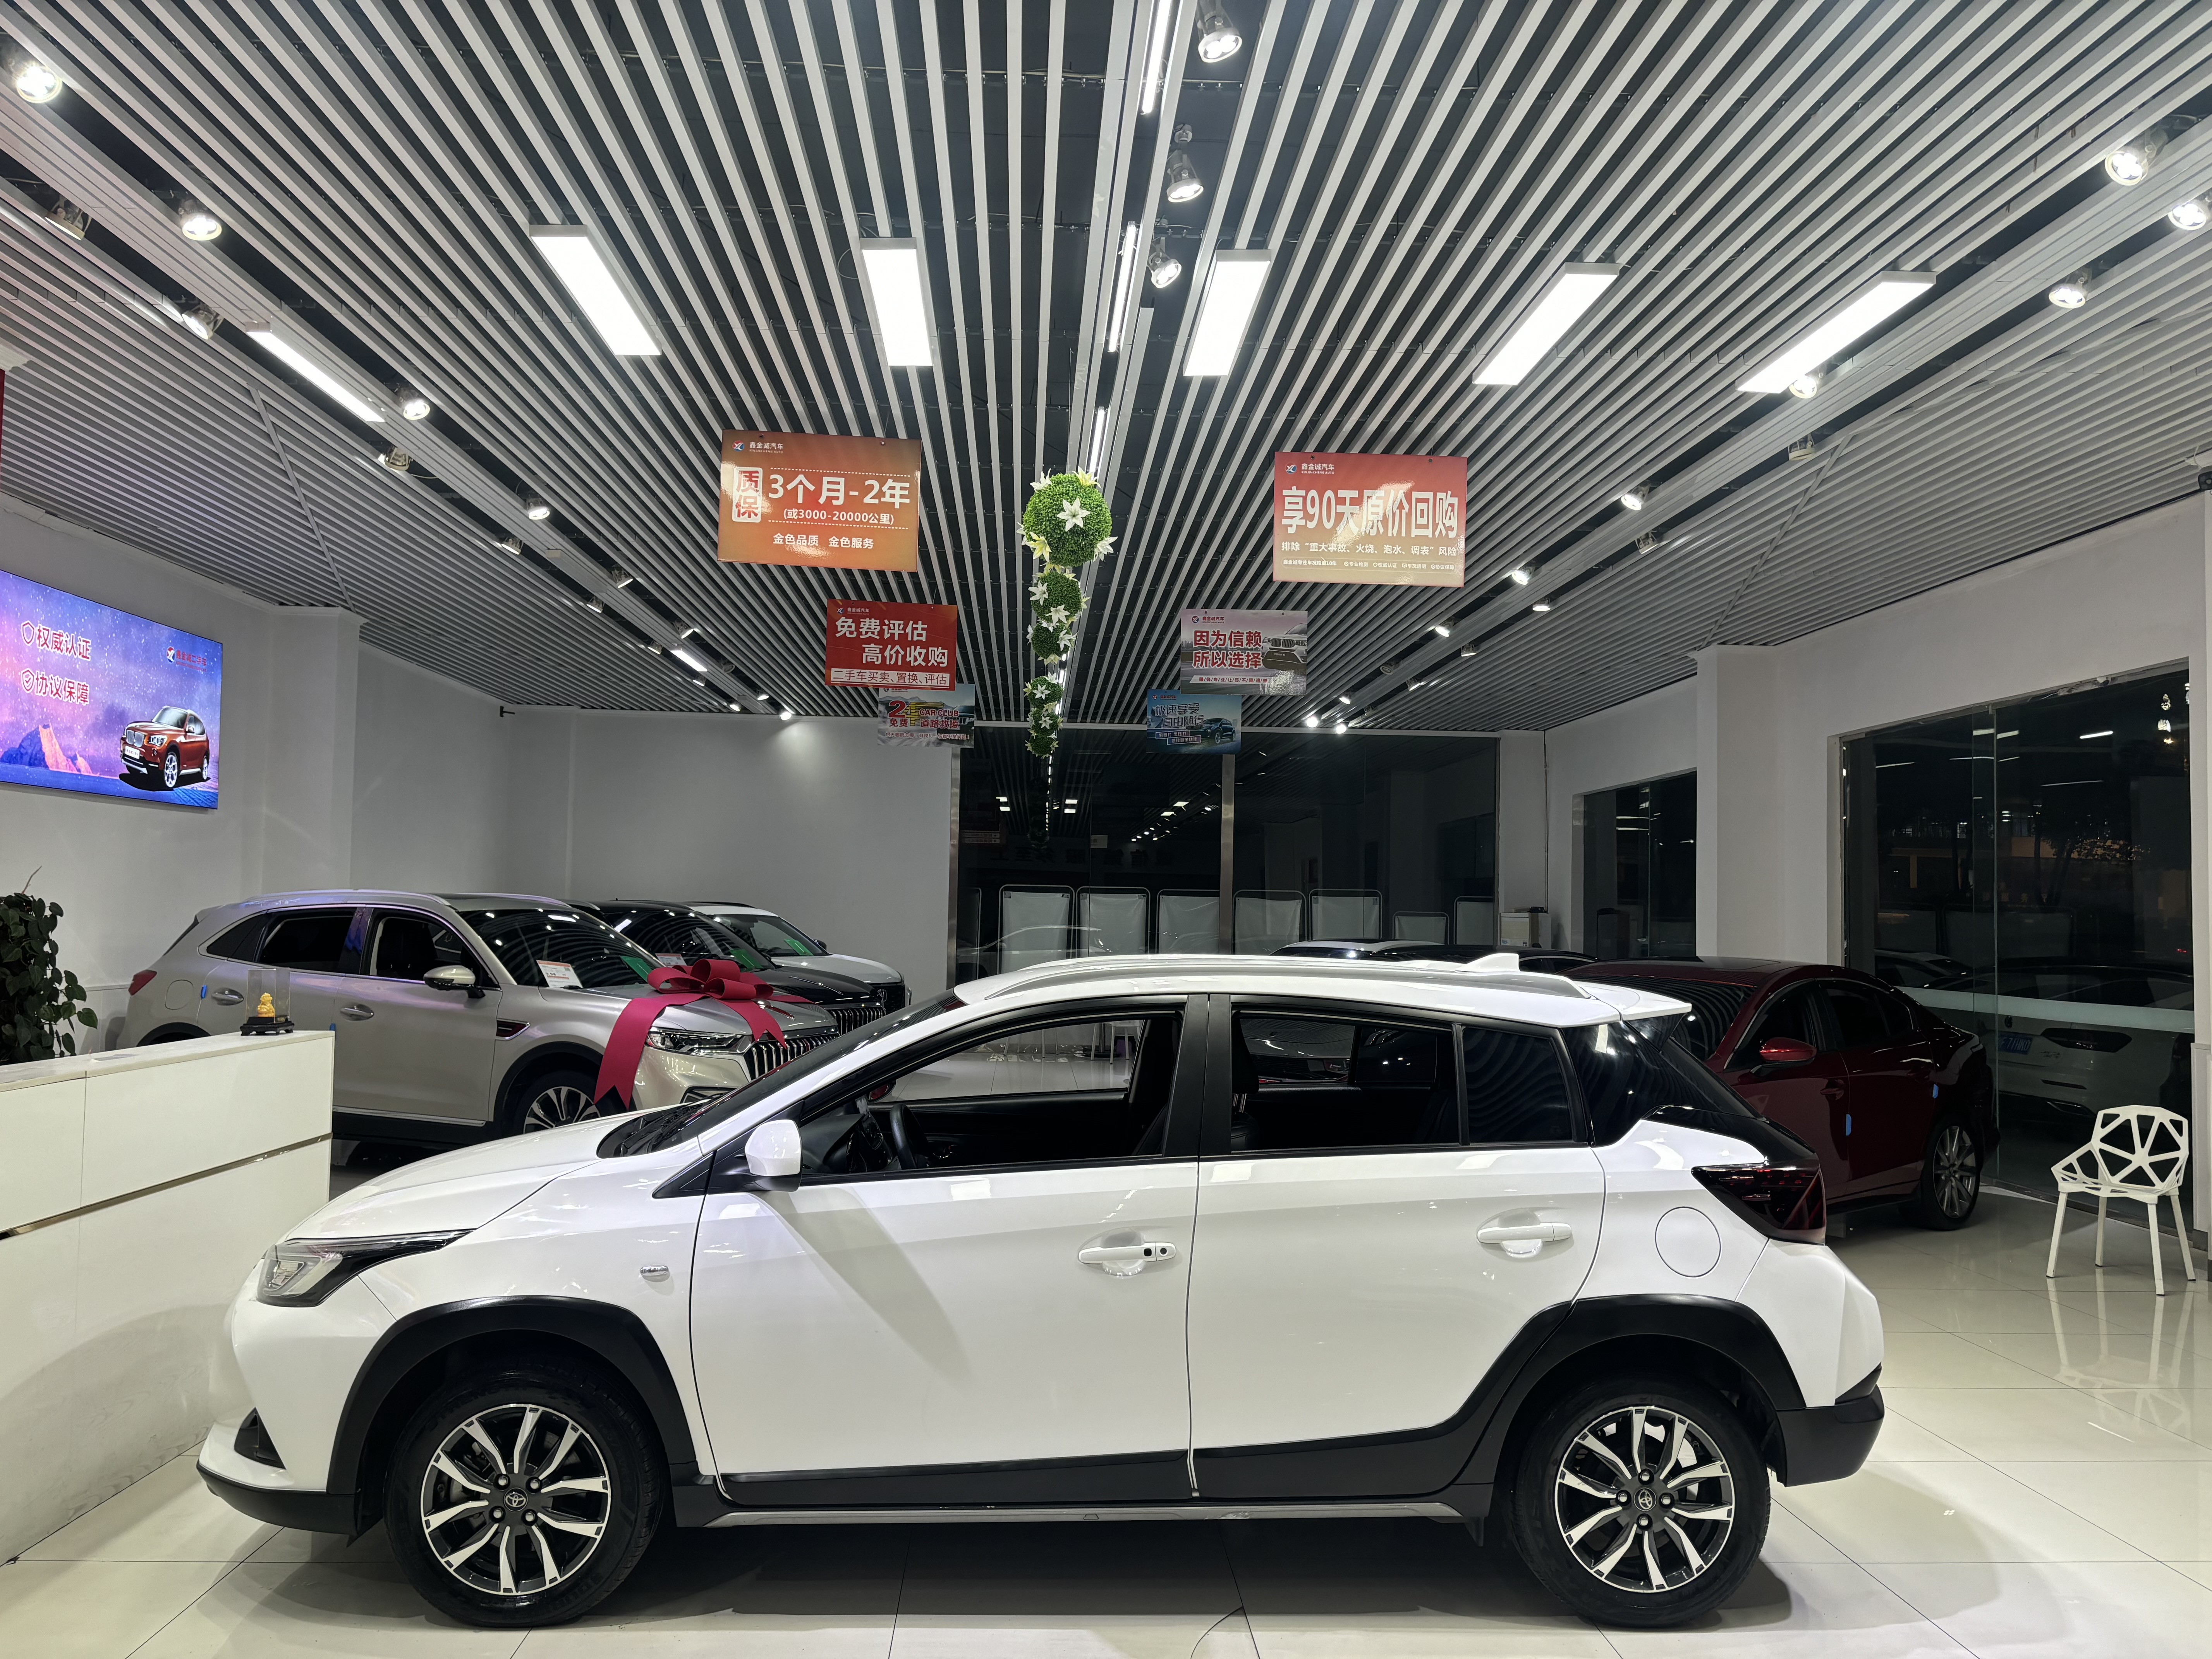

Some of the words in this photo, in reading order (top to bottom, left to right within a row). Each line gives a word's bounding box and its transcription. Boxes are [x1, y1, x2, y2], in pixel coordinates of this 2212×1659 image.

[768, 474, 910, 509] 3个月-2年
[783, 508, 894, 526] (或3000-20000公里)
[1282, 486, 1458, 538] 享90天原价回购
[773, 533, 819, 546] 金色品质
[828, 536, 874, 549] 金色服务
[835, 616, 927, 642] 免费评估
[37, 625, 91, 661] 权威认证
[1194, 630, 1262, 648] 因为信赖
[862, 643, 948, 667] 高价收购
[1193, 651, 1262, 669] 所以选择
[833, 670, 947, 685] 二手车买卖、置换、评估
[35, 672, 90, 706] 协议保障
[1155, 702, 1200, 716] 极速享受
[889, 718, 908, 727] 免费
[920, 719, 960, 729] 道路救援
[1163, 715, 1204, 728] 自由随行
